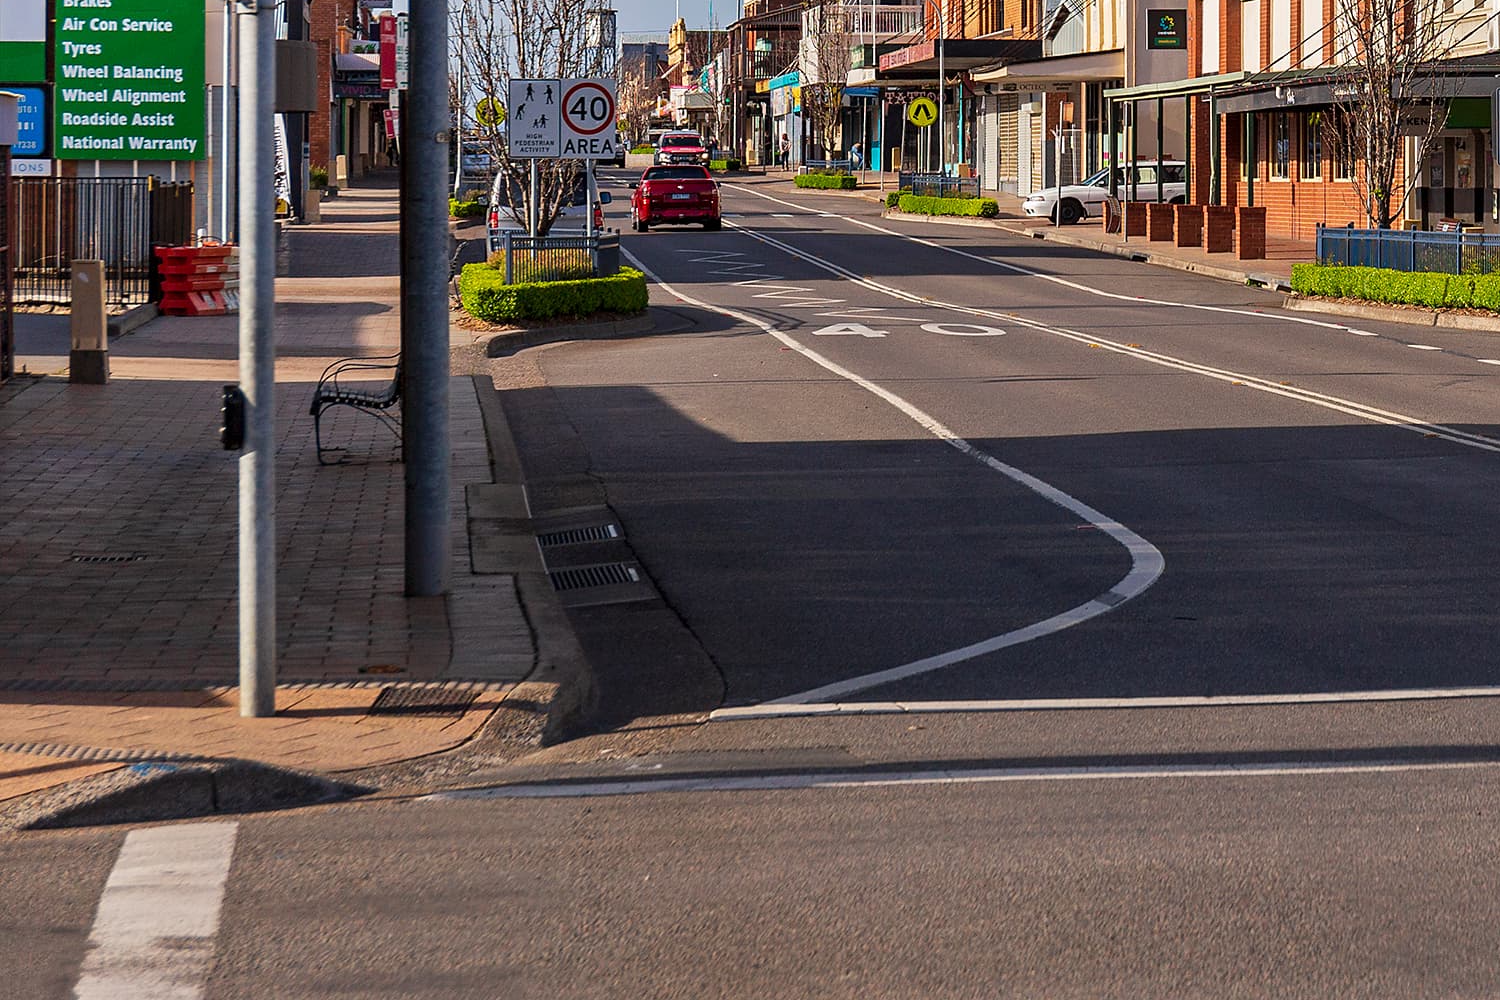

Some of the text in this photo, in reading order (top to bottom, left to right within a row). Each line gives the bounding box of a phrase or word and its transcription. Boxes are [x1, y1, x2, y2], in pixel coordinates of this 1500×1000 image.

[62, 17, 173, 31] Air Con Service
[62, 41, 101, 58] Tyres
[62, 65, 183, 83] Wheel Balancing
[62, 89, 186, 106] Wheel Alignment
[569, 96, 607, 121] 40
[62, 113, 175, 126] Roadside Assist
[62, 136, 197, 153] National Warranty
[563, 139, 614, 154] AREA
